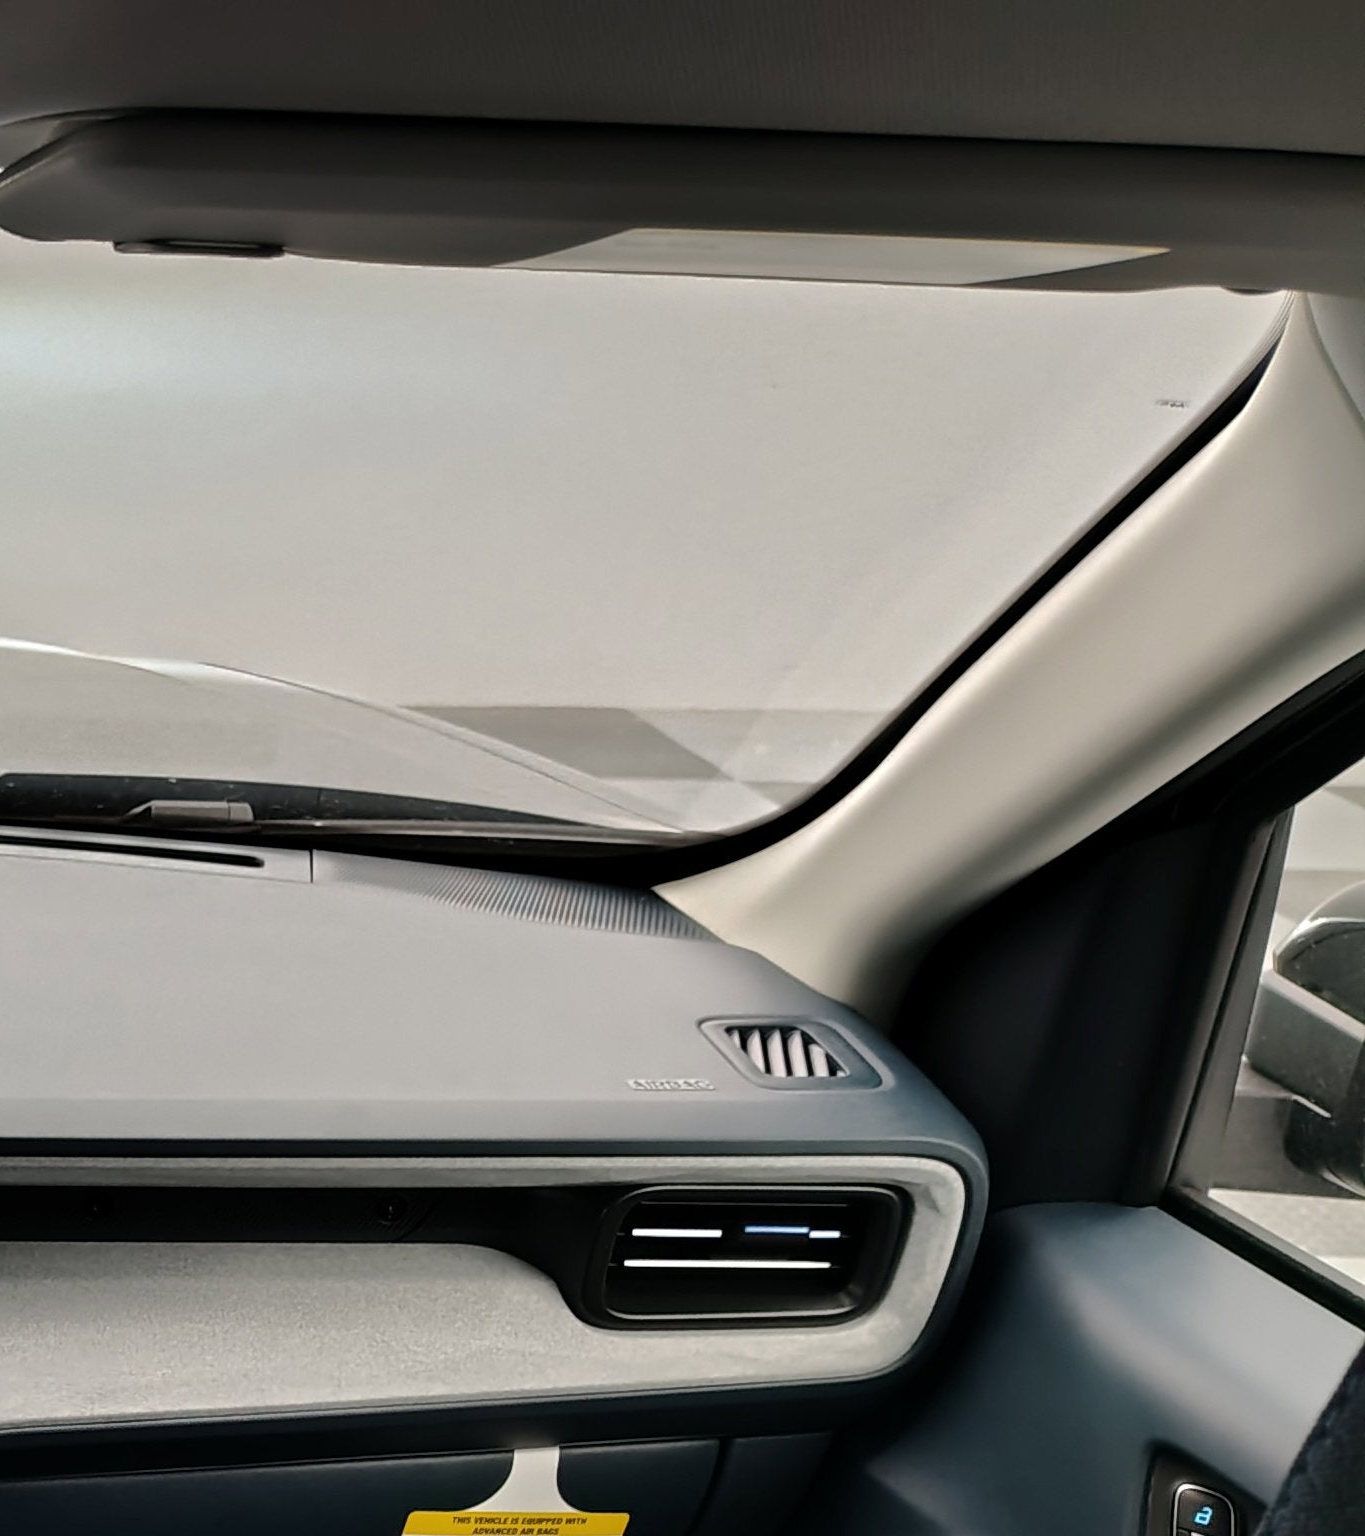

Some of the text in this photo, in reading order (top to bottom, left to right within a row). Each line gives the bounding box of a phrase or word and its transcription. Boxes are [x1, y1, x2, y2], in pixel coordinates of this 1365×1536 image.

[453, 1516, 587, 1526] THIS VEHICLE IS EQUIPPED WITH
[472, 1527, 560, 1536] ADVANCED AIR BAGS
